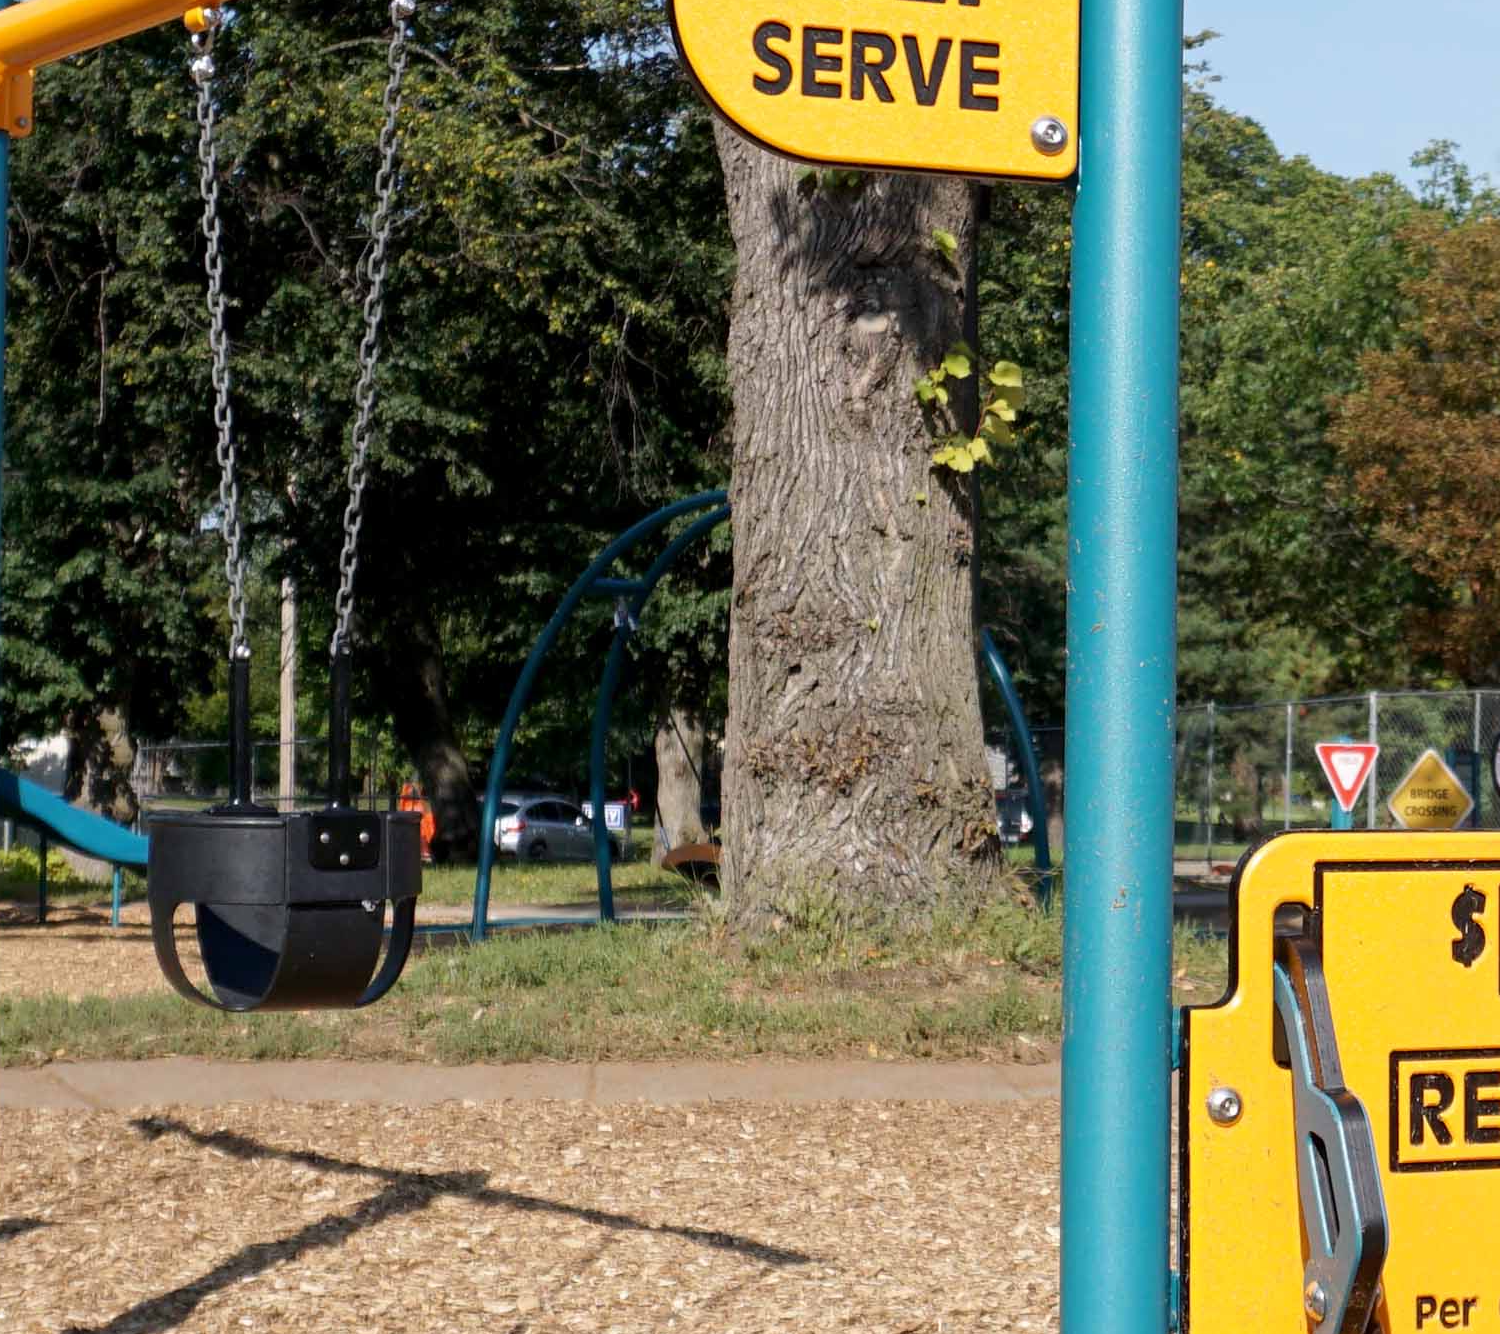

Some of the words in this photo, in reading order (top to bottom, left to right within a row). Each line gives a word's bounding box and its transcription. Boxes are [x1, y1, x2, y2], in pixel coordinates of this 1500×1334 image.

[752, 20, 1000, 112] SERVE
[1410, 788, 1450, 799] BRIDGE
[1404, 805, 1457, 817] CROSSING
[1416, 1295, 1477, 1330] Per
